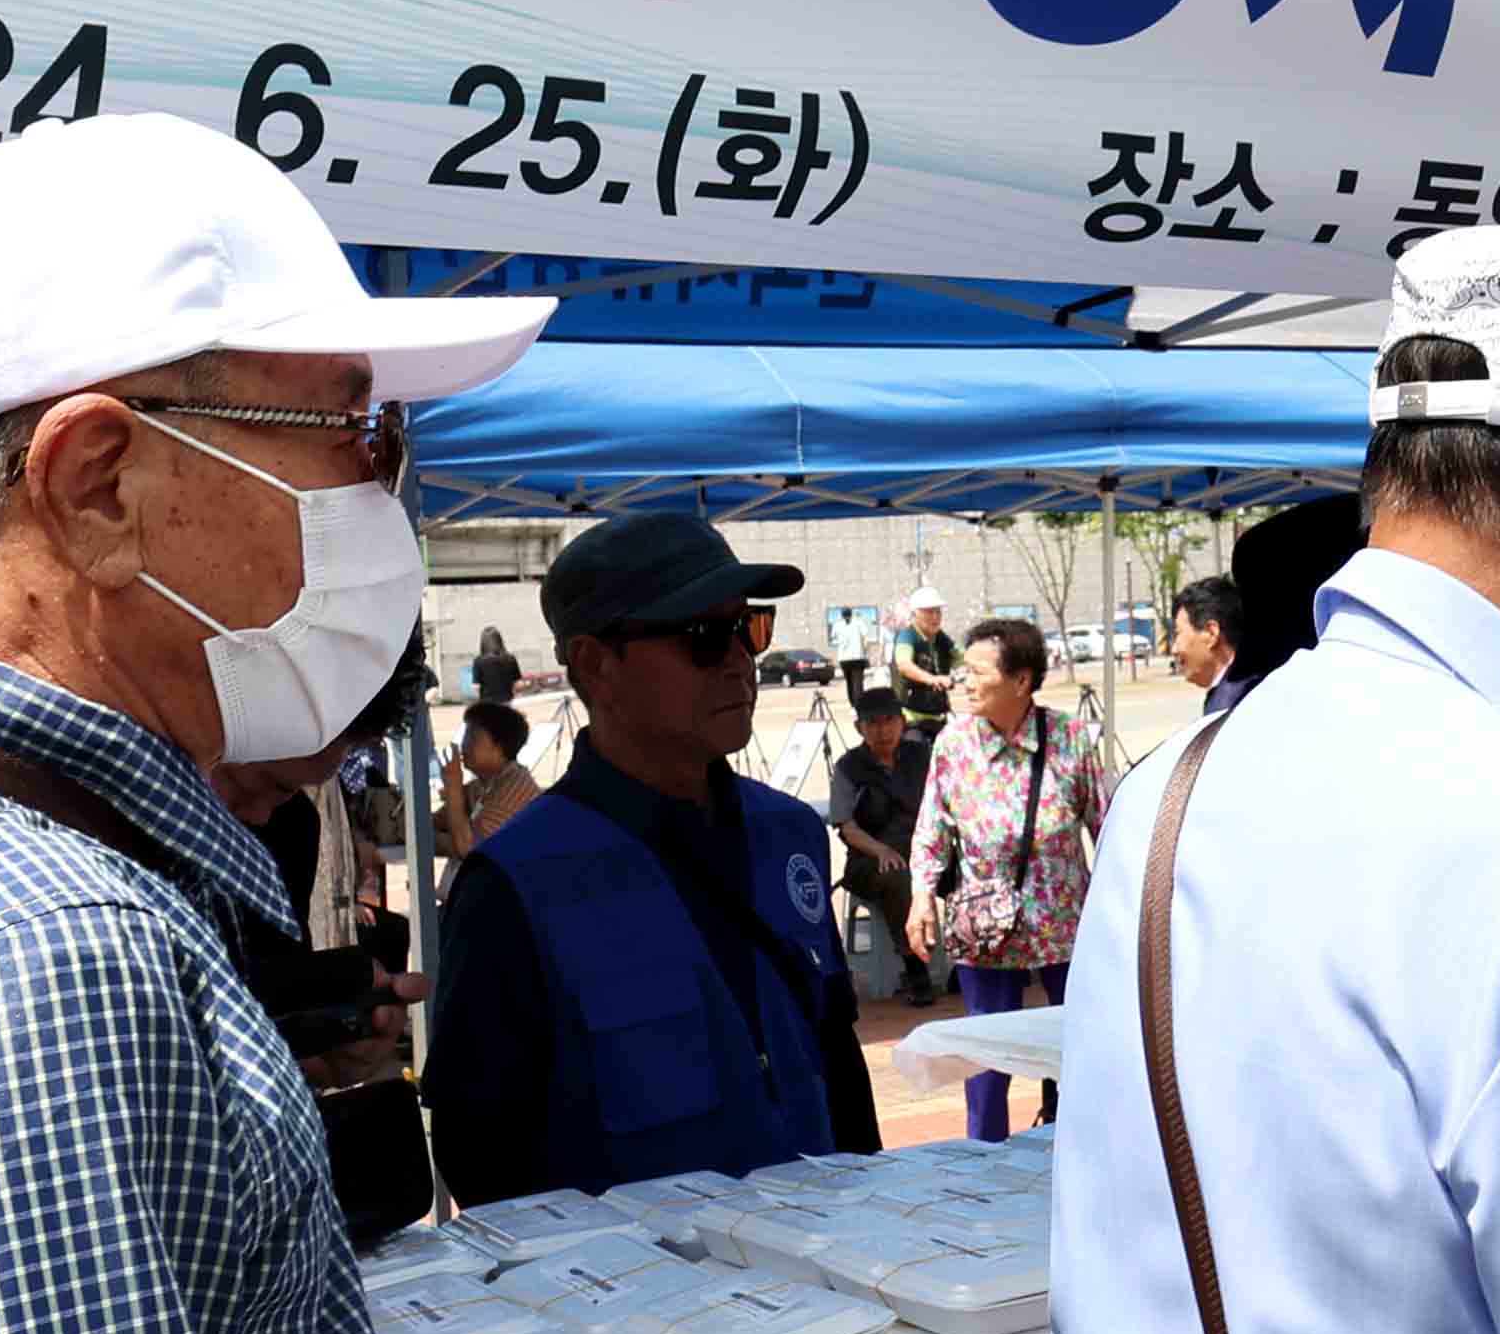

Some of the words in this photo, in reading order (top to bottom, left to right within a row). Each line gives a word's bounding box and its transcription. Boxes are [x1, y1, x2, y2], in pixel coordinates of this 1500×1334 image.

[235, 43, 359, 184] 6.
[427, 64, 871, 227] 25.(화)
[1082, 130, 1276, 243] 장소
[1312, 169, 1360, 244] :
